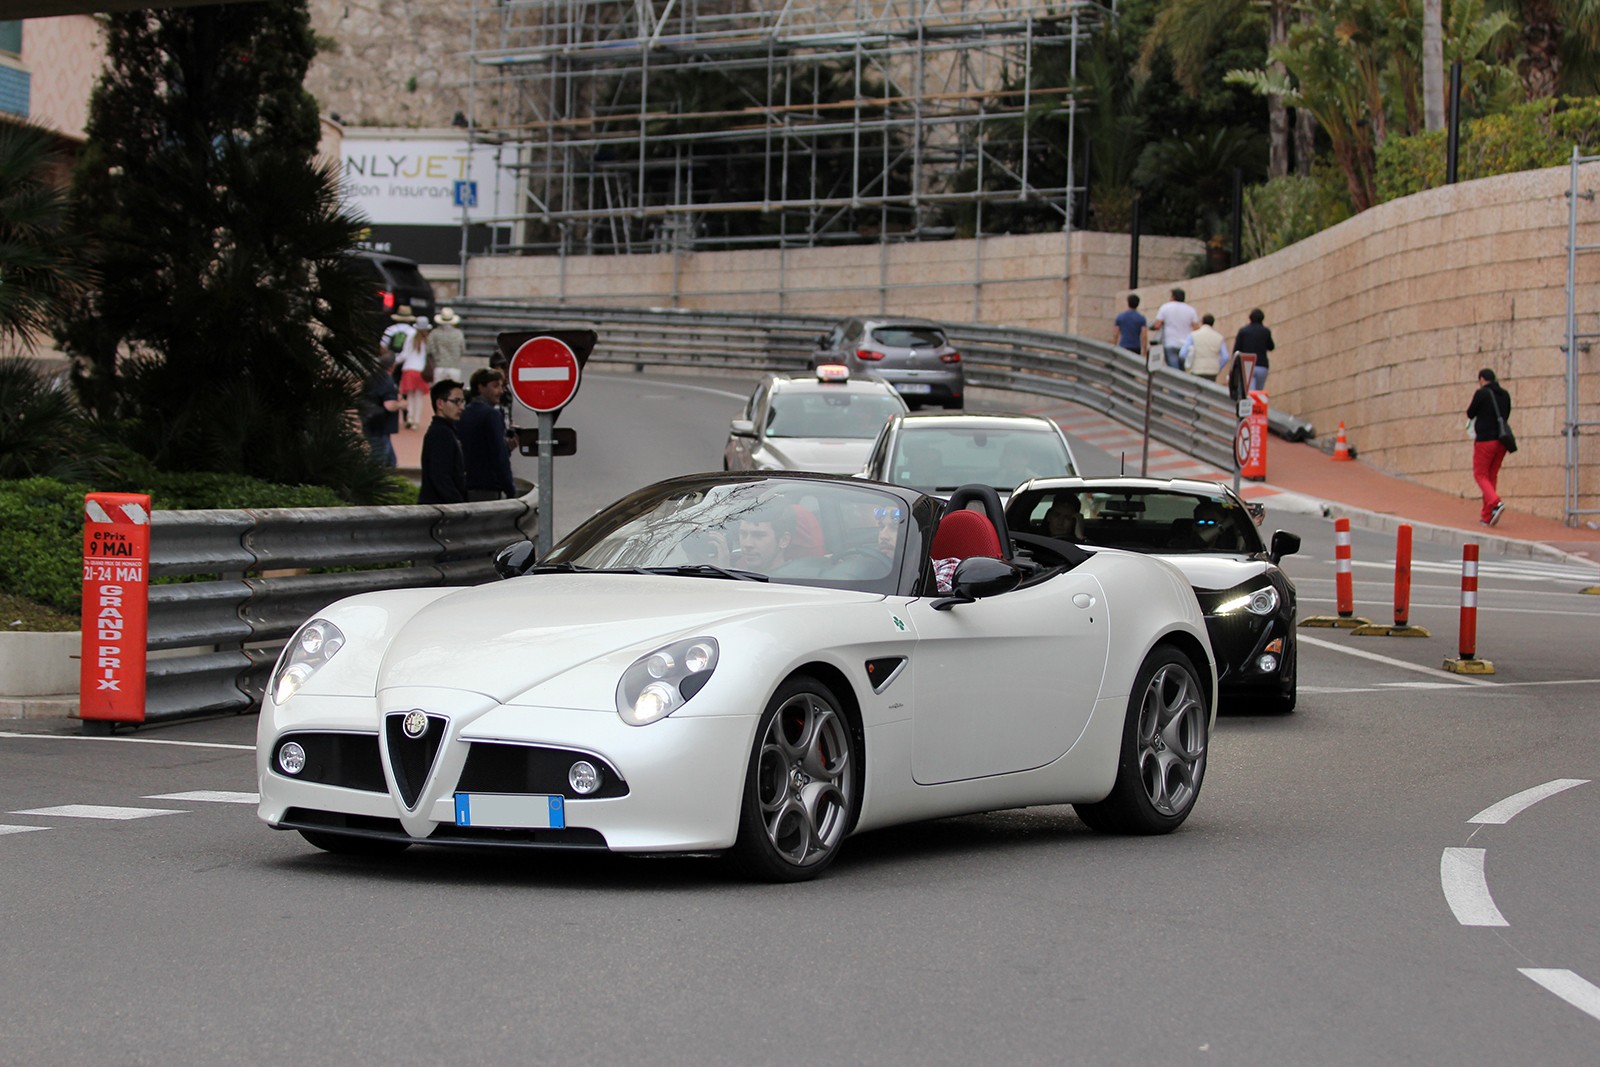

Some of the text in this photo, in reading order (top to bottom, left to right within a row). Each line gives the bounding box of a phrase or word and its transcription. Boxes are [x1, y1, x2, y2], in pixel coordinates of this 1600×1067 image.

[346, 155, 474, 178] NLYJET
[388, 183, 455, 198] insuran
[90, 541, 132, 556] 9 MAI
[84, 566, 142, 582] 21-24 MAI
[98, 585, 123, 640] GRAND
[97, 646, 121, 691] PRIX
